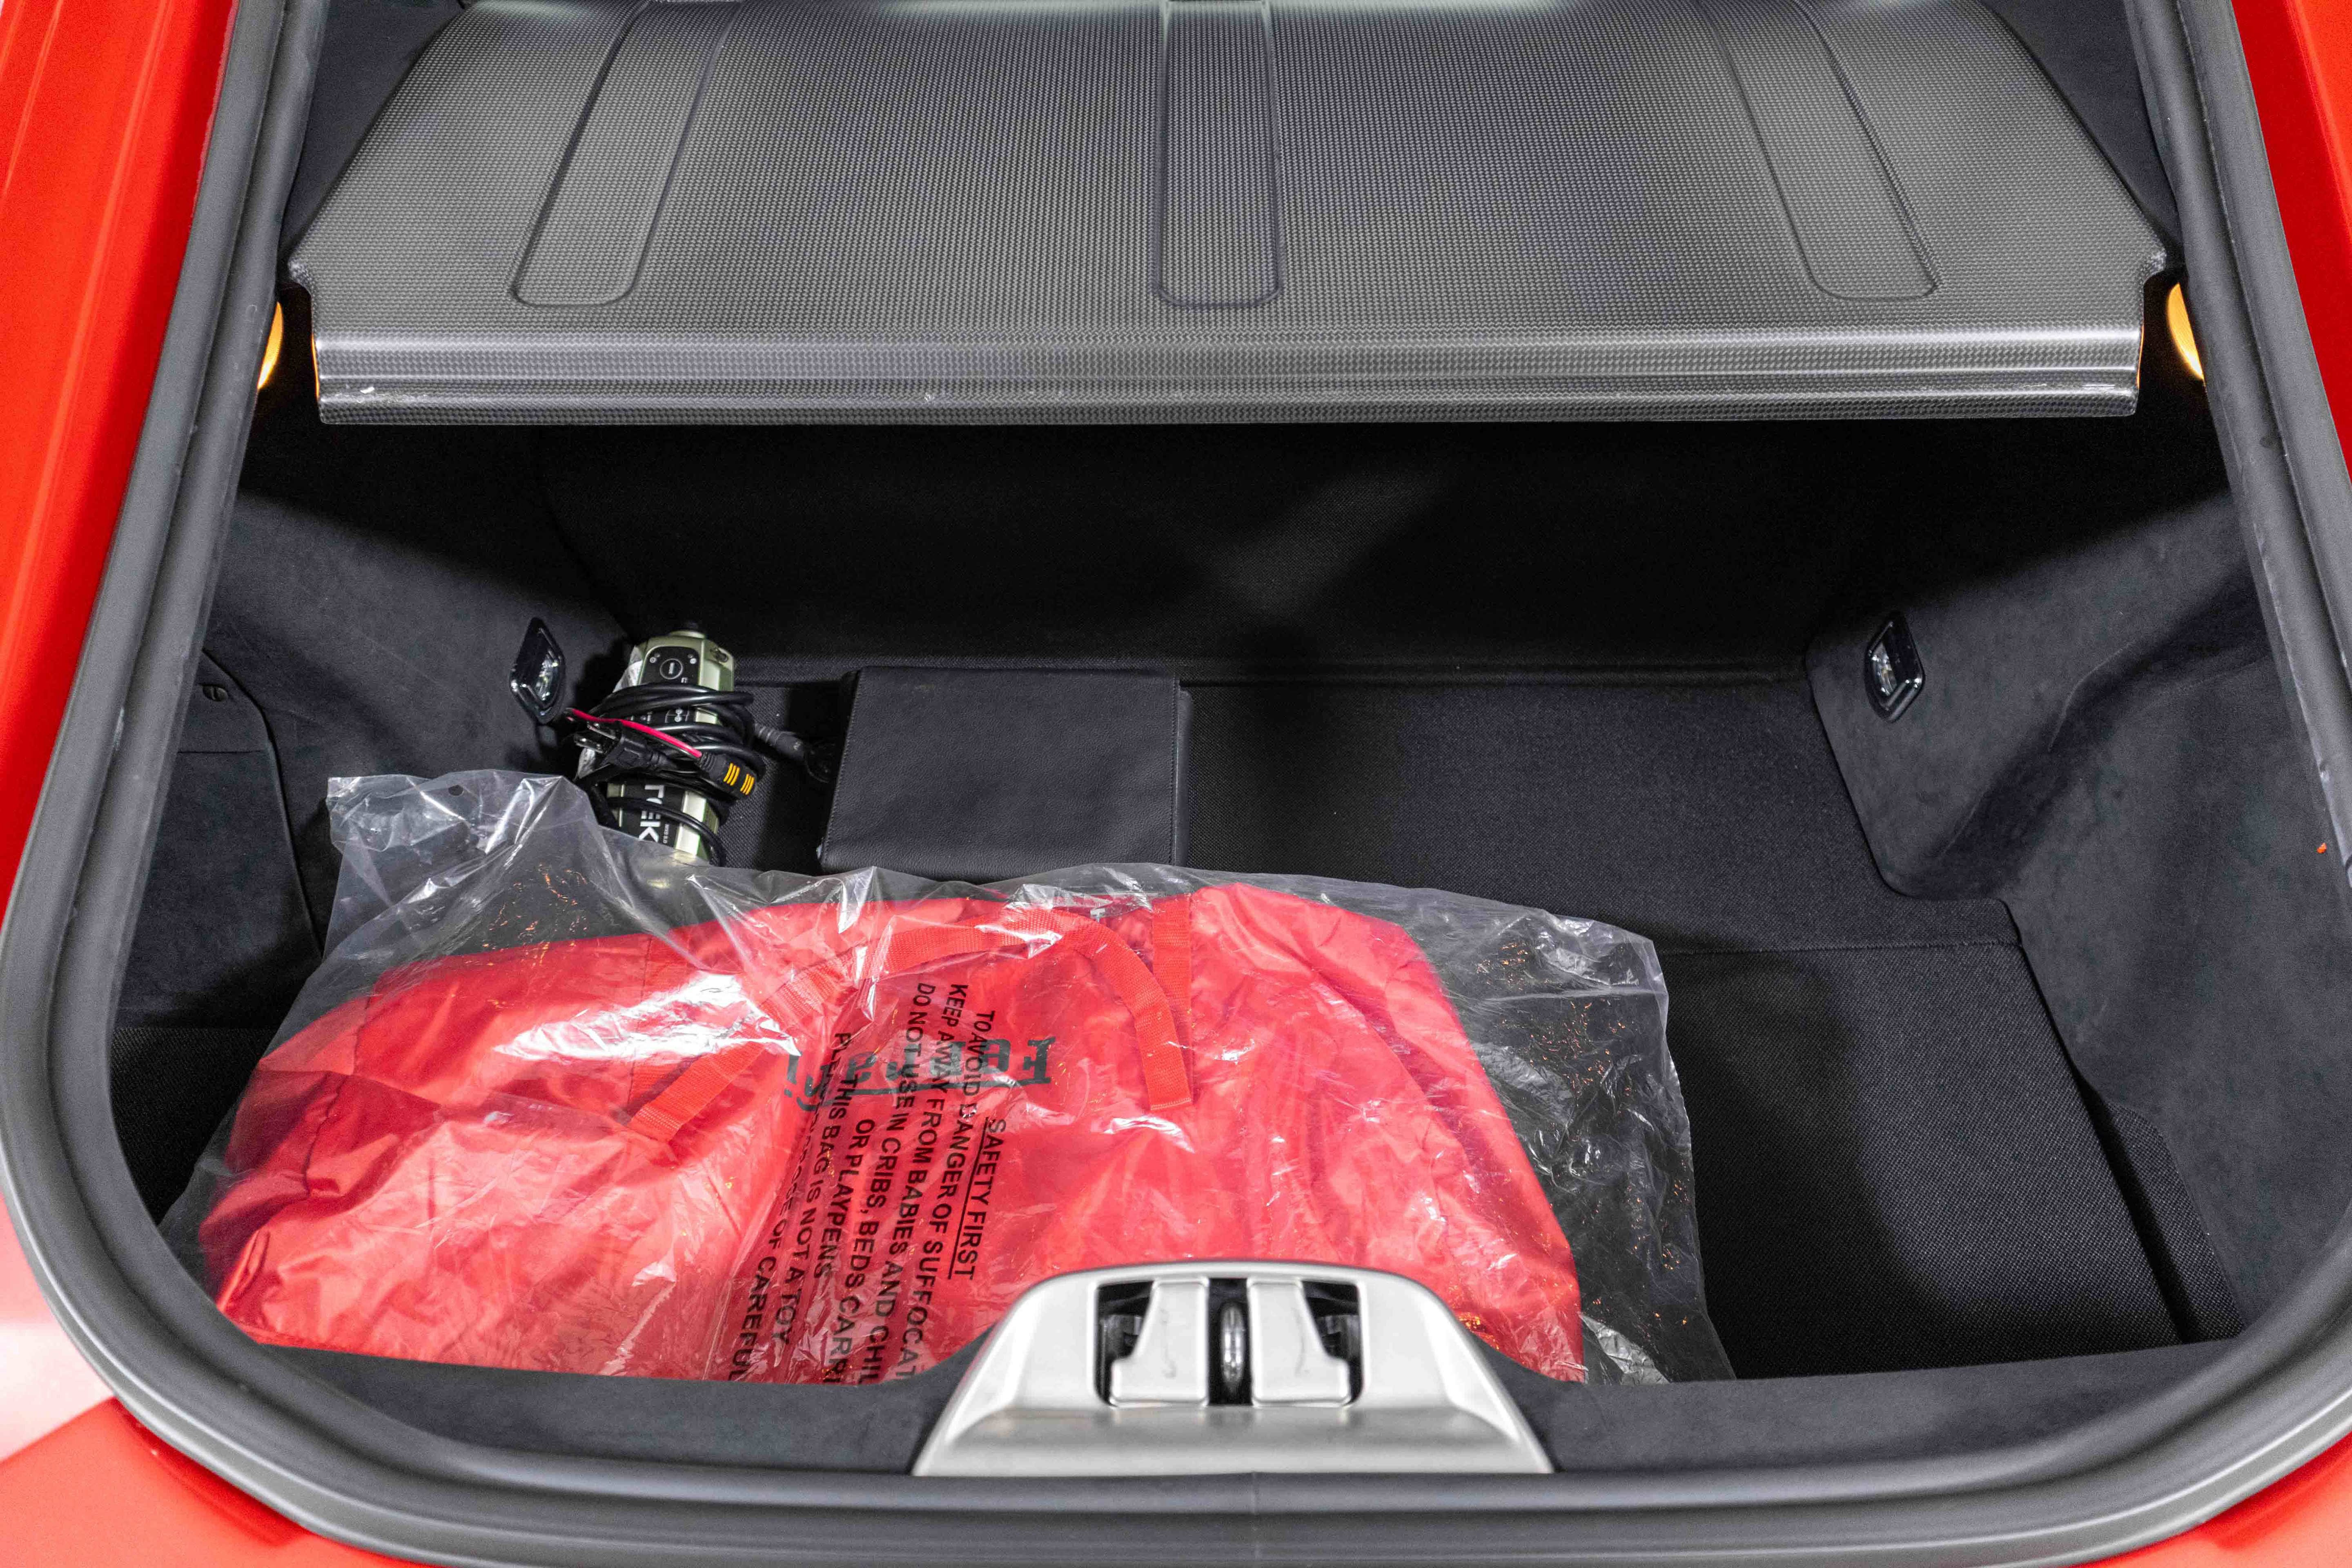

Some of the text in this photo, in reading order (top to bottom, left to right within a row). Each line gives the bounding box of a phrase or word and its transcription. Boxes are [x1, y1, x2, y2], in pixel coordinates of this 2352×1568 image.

[913, 983, 936, 1007] DO
[941, 984, 969, 1027] KEEP
[973, 1010, 996, 1032] TO
[904, 1011, 928, 1057] NOT
[931, 1031, 955, 1094] AWAY
[963, 1032, 988, 1096] AVOID
[784, 1037, 1056, 1111] Ferrari
[895, 1063, 920, 1109] USE
[886, 1112, 909, 1131] IN
[912, 1099, 945, 1163] FROM
[937, 1102, 978, 1199] DANGER
[814, 1119, 875, 1278] OR PLAYPENS
[860, 1137, 901, 1214] CRIBS,
[954, 1119, 1007, 1280] SAFETY FIRST
[768, 1218, 787, 1250] OF
[771, 1074, 858, 1345] THIS BAG IS NOT A TOY
[889, 1169, 928, 1255] BABIES
[929, 1203, 952, 1234] OF
[845, 1221, 880, 1288] BEDS
[875, 1260, 903, 1317] AND
